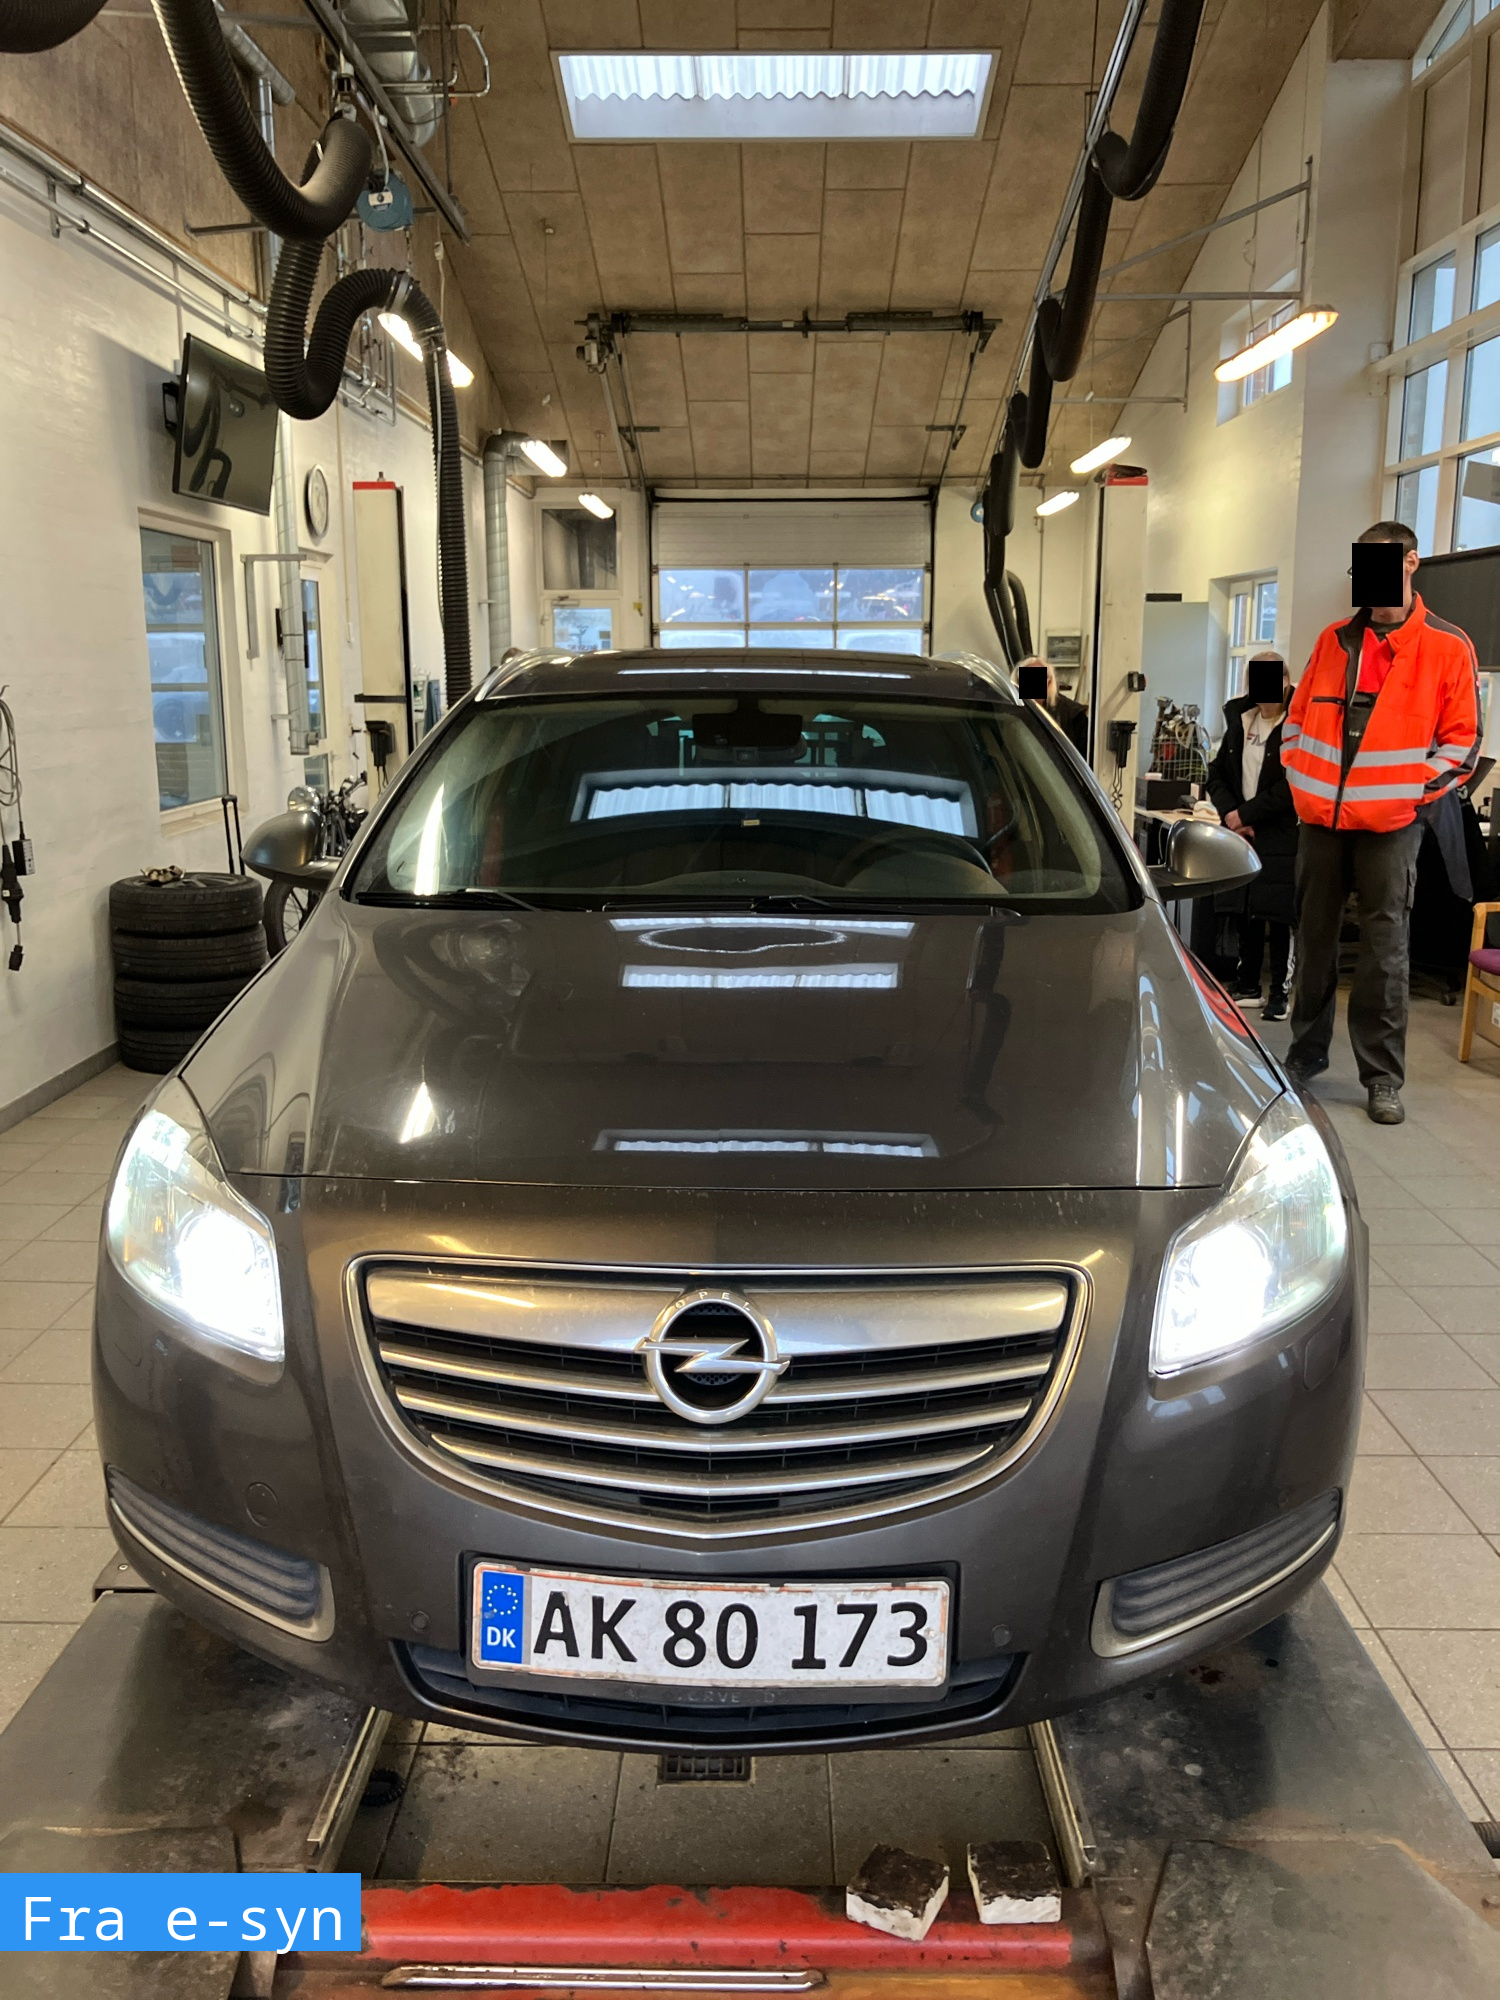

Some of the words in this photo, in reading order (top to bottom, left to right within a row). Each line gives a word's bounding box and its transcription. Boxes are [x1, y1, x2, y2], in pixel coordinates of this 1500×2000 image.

[675, 1291, 750, 1311] OPEL
[486, 1625, 516, 1649] DK
[533, 1590, 638, 1662] AK
[663, 1600, 759, 1669] 80
[791, 1601, 929, 1670] 173
